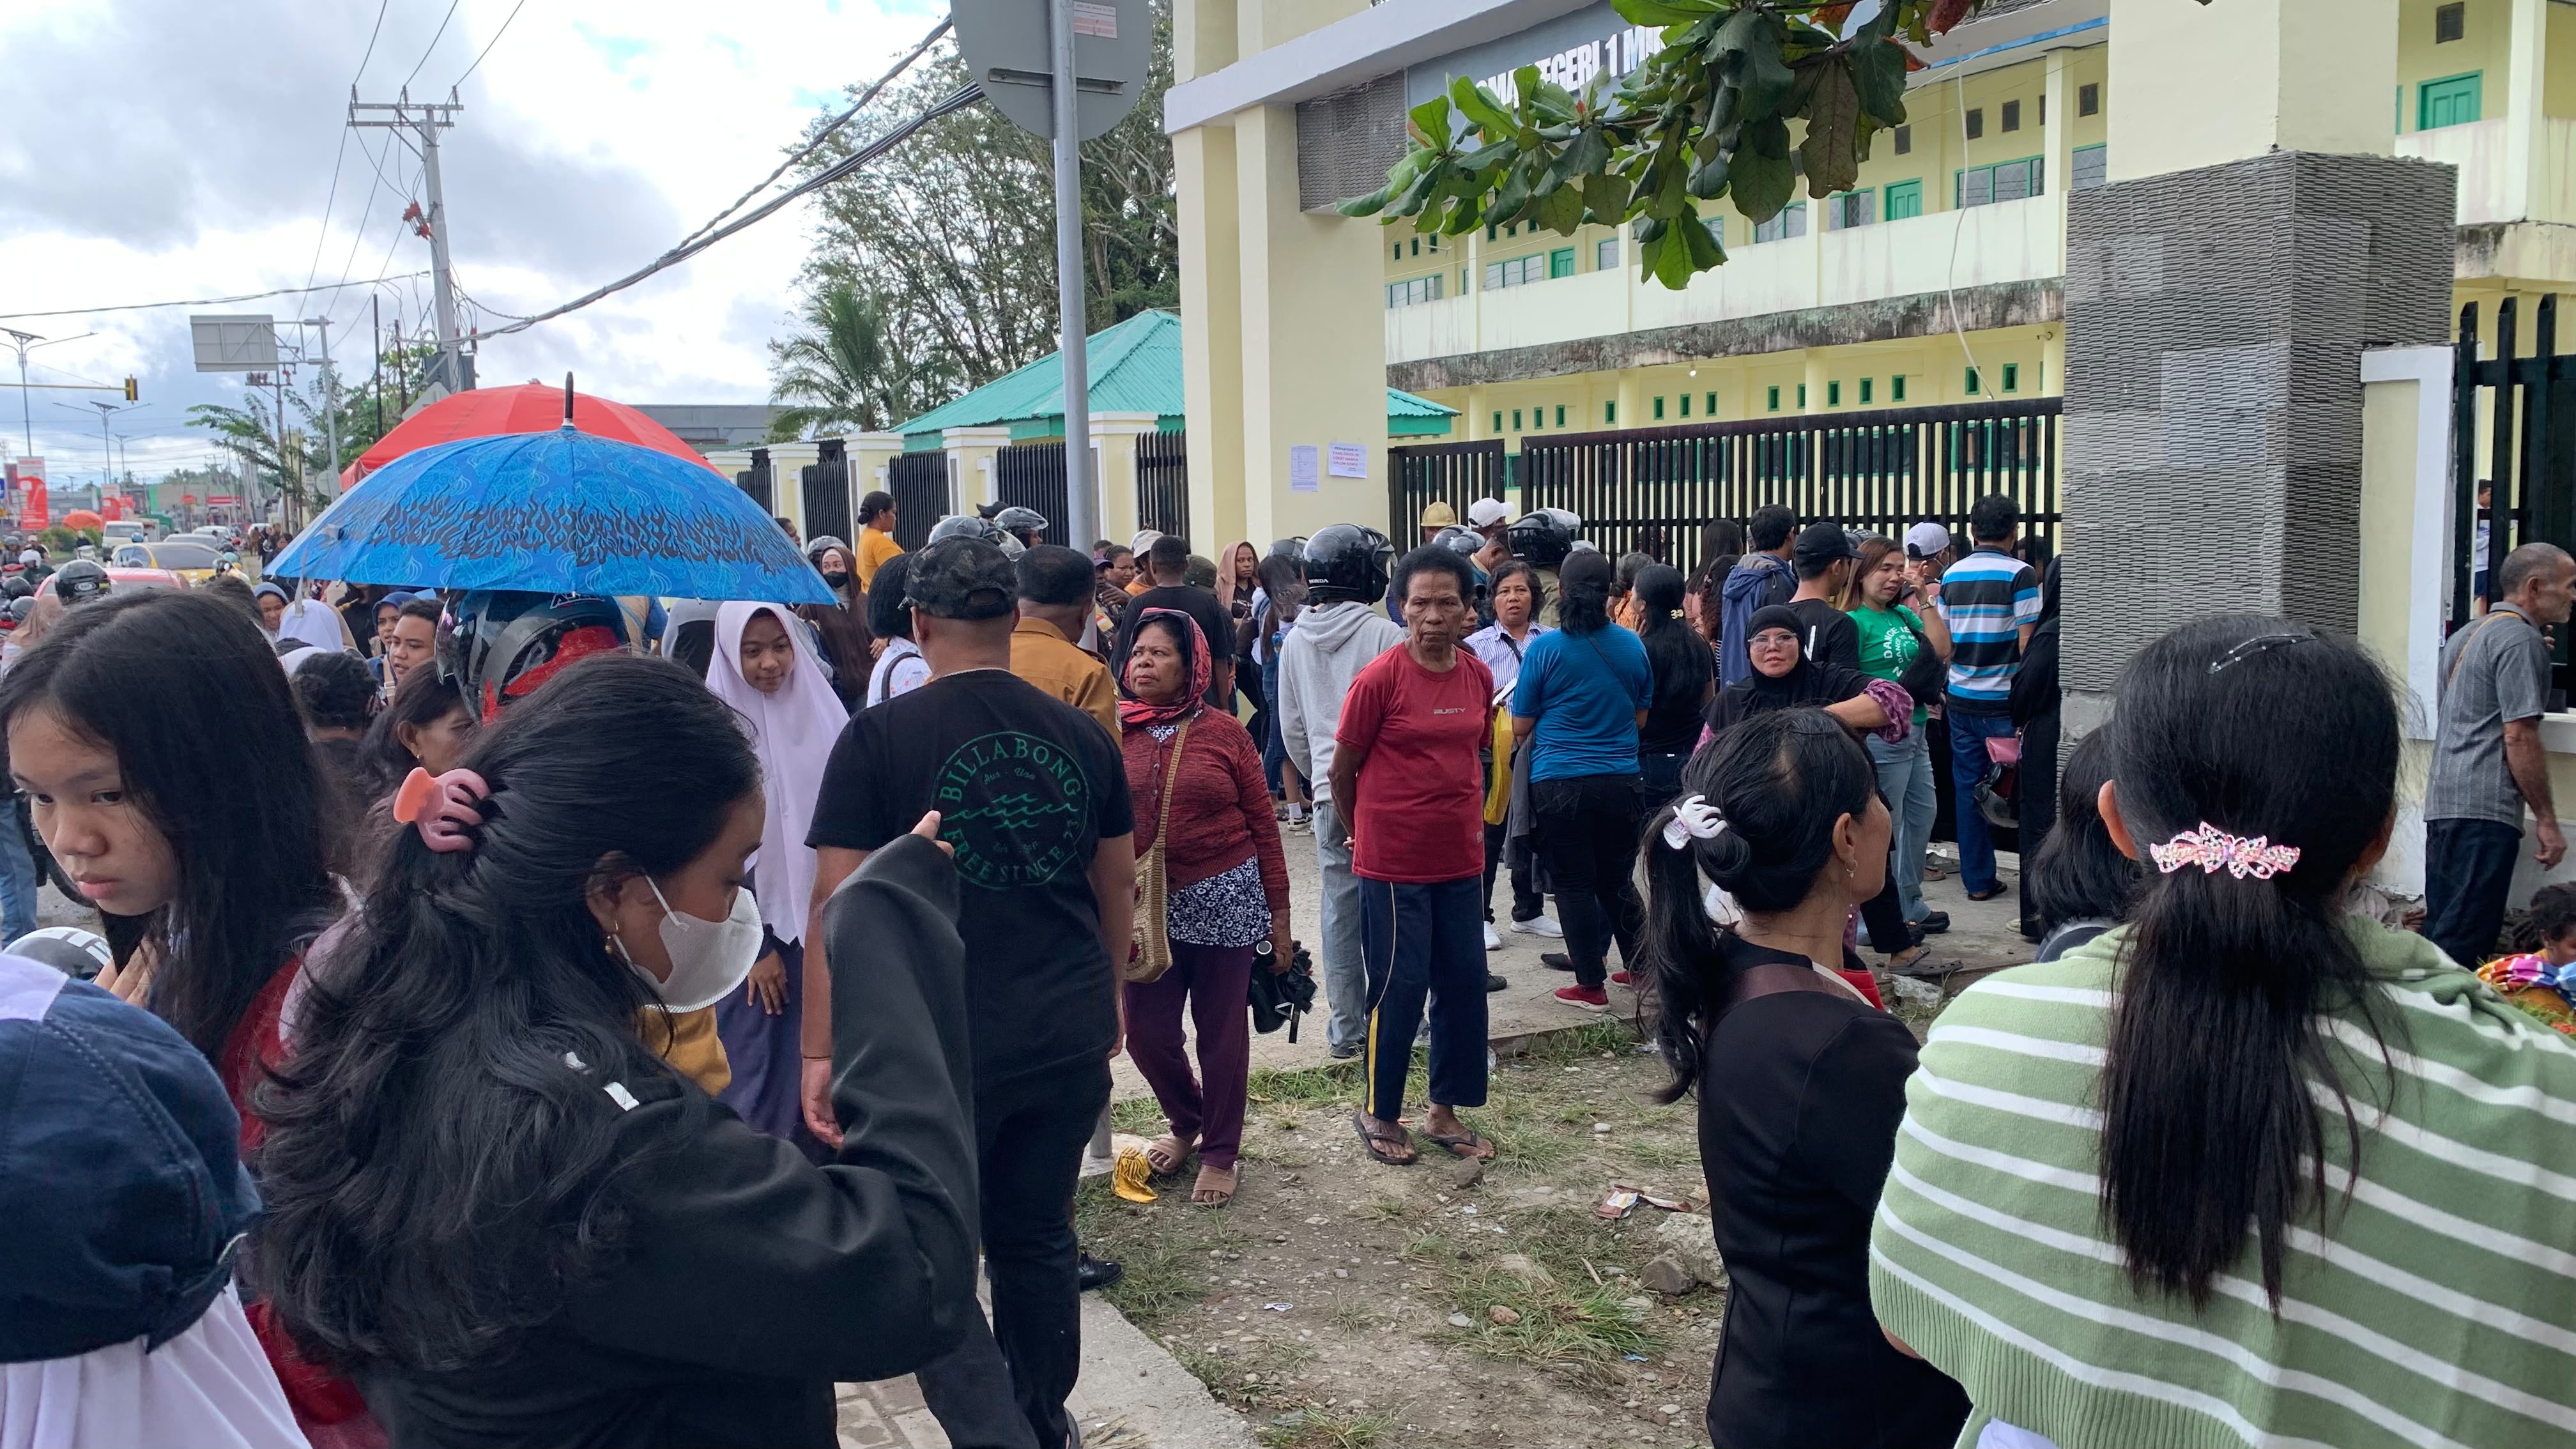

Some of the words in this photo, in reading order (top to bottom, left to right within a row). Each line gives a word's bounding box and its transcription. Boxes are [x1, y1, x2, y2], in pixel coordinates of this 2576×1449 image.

[1476, 68, 1520, 109] MA
[1528, 40, 1600, 93] EGERI
[1605, 33, 1618, 77] 1
[939, 738, 1082, 802] BILLABONG
[944, 829, 993, 879] FREE
[999, 846, 1064, 882] SINCE
